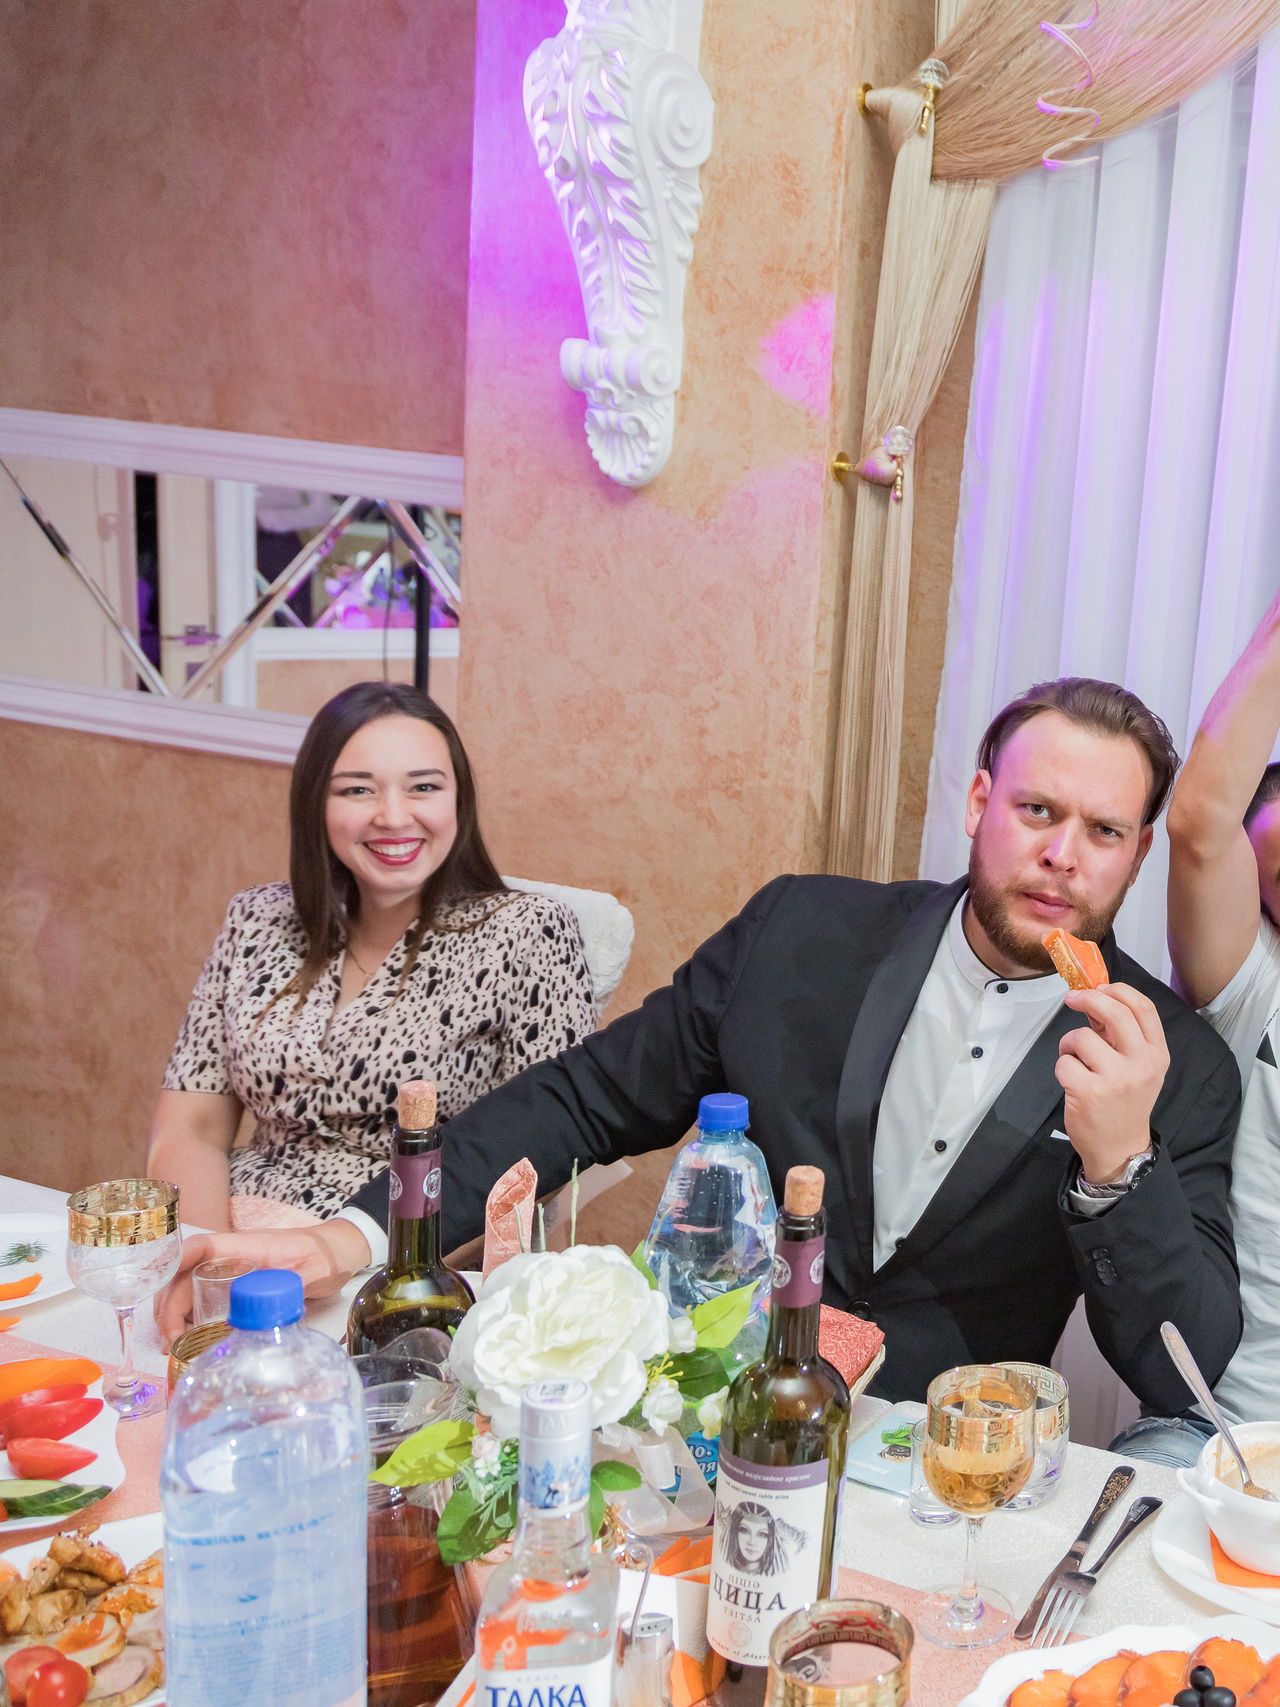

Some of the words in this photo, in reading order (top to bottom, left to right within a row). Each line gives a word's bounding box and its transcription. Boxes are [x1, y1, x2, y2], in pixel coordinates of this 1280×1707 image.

[785, 1472, 811, 1484] красное
[713, 1571, 787, 1614] ЦИЦА
[723, 1605, 762, 1623] TSITSA
[484, 1684, 588, 1707] ТАЛКА
